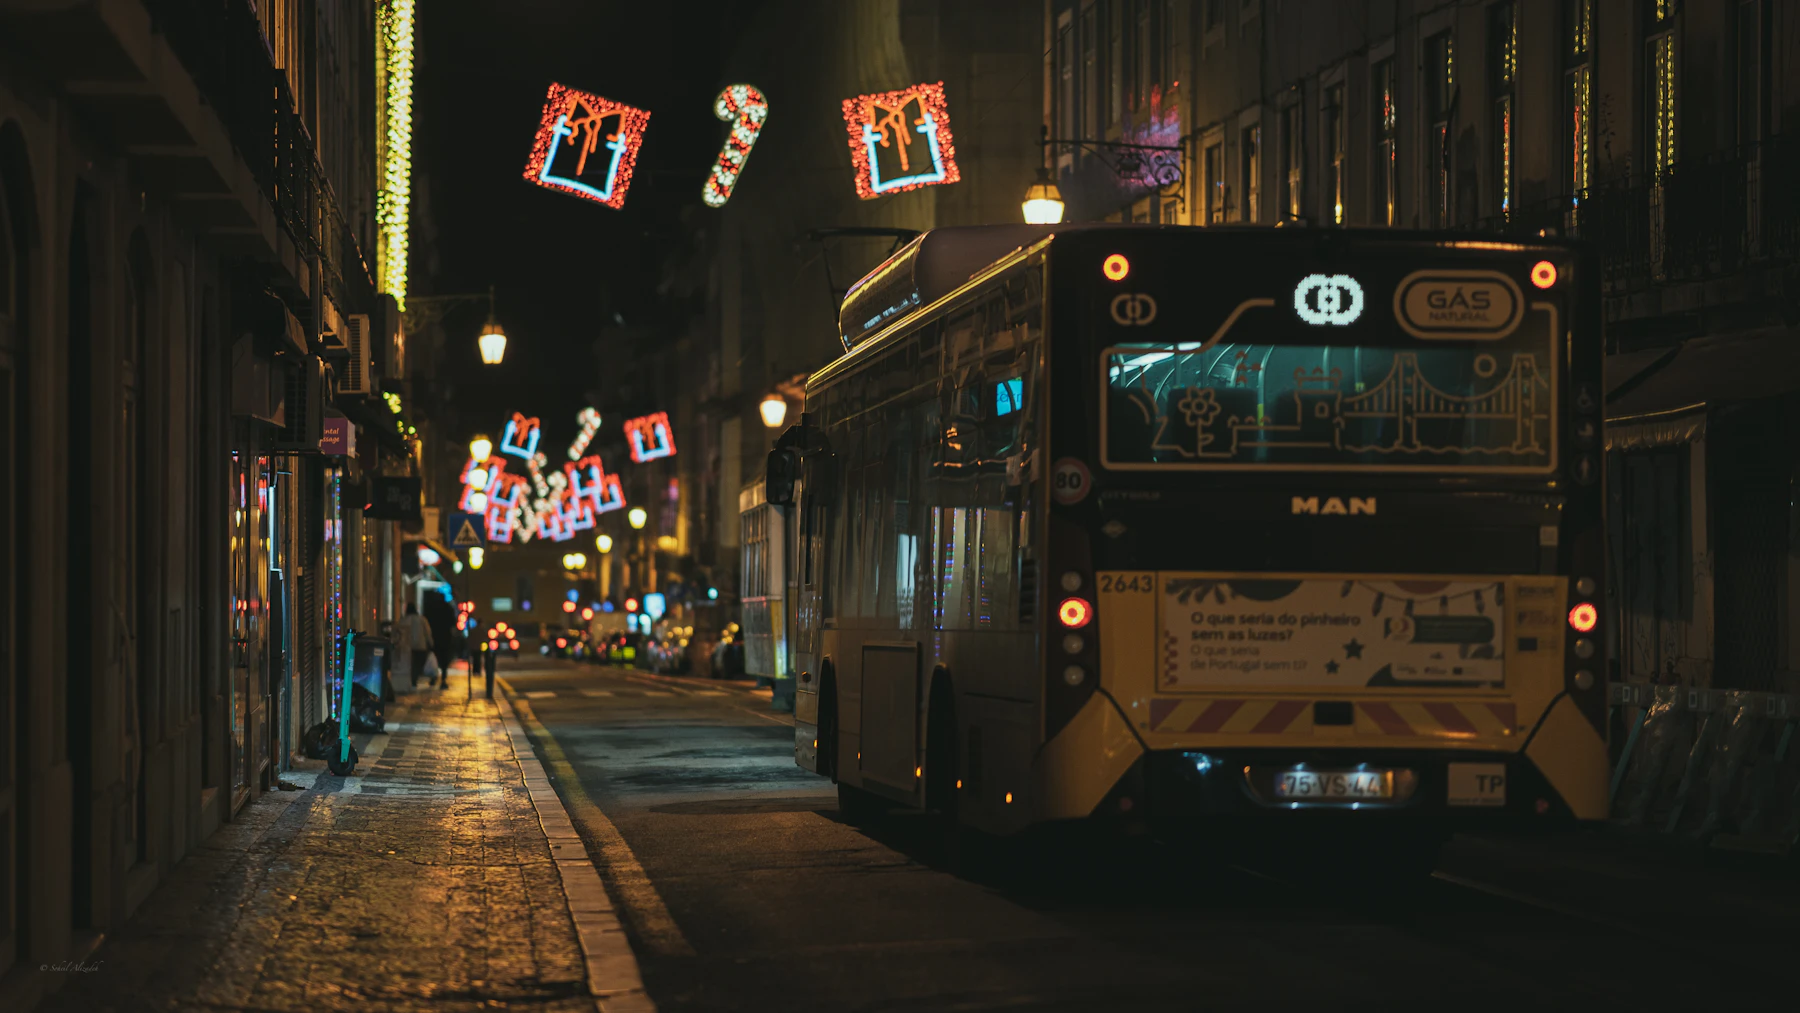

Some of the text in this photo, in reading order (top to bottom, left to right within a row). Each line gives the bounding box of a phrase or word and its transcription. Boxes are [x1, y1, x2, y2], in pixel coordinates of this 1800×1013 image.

[1427, 286, 1491, 310] GÁS
[1429, 311, 1490, 321] NATURAL
[323, 436, 340, 445] ssage
[1055, 472, 1082, 489] 80
[1291, 496, 1377, 515] MAN
[1100, 575, 1153, 593] 2643
[1191, 611, 1361, 628] O que seria do pinheiro
[1191, 628, 1294, 641] sem as luzes?
[1191, 644, 1260, 657] O que seria
[1191, 659, 1206, 670] de
[1209, 659, 1261, 672] Portugal
[1264, 661, 1290, 670] sem
[1475, 774, 1504, 794] TP
